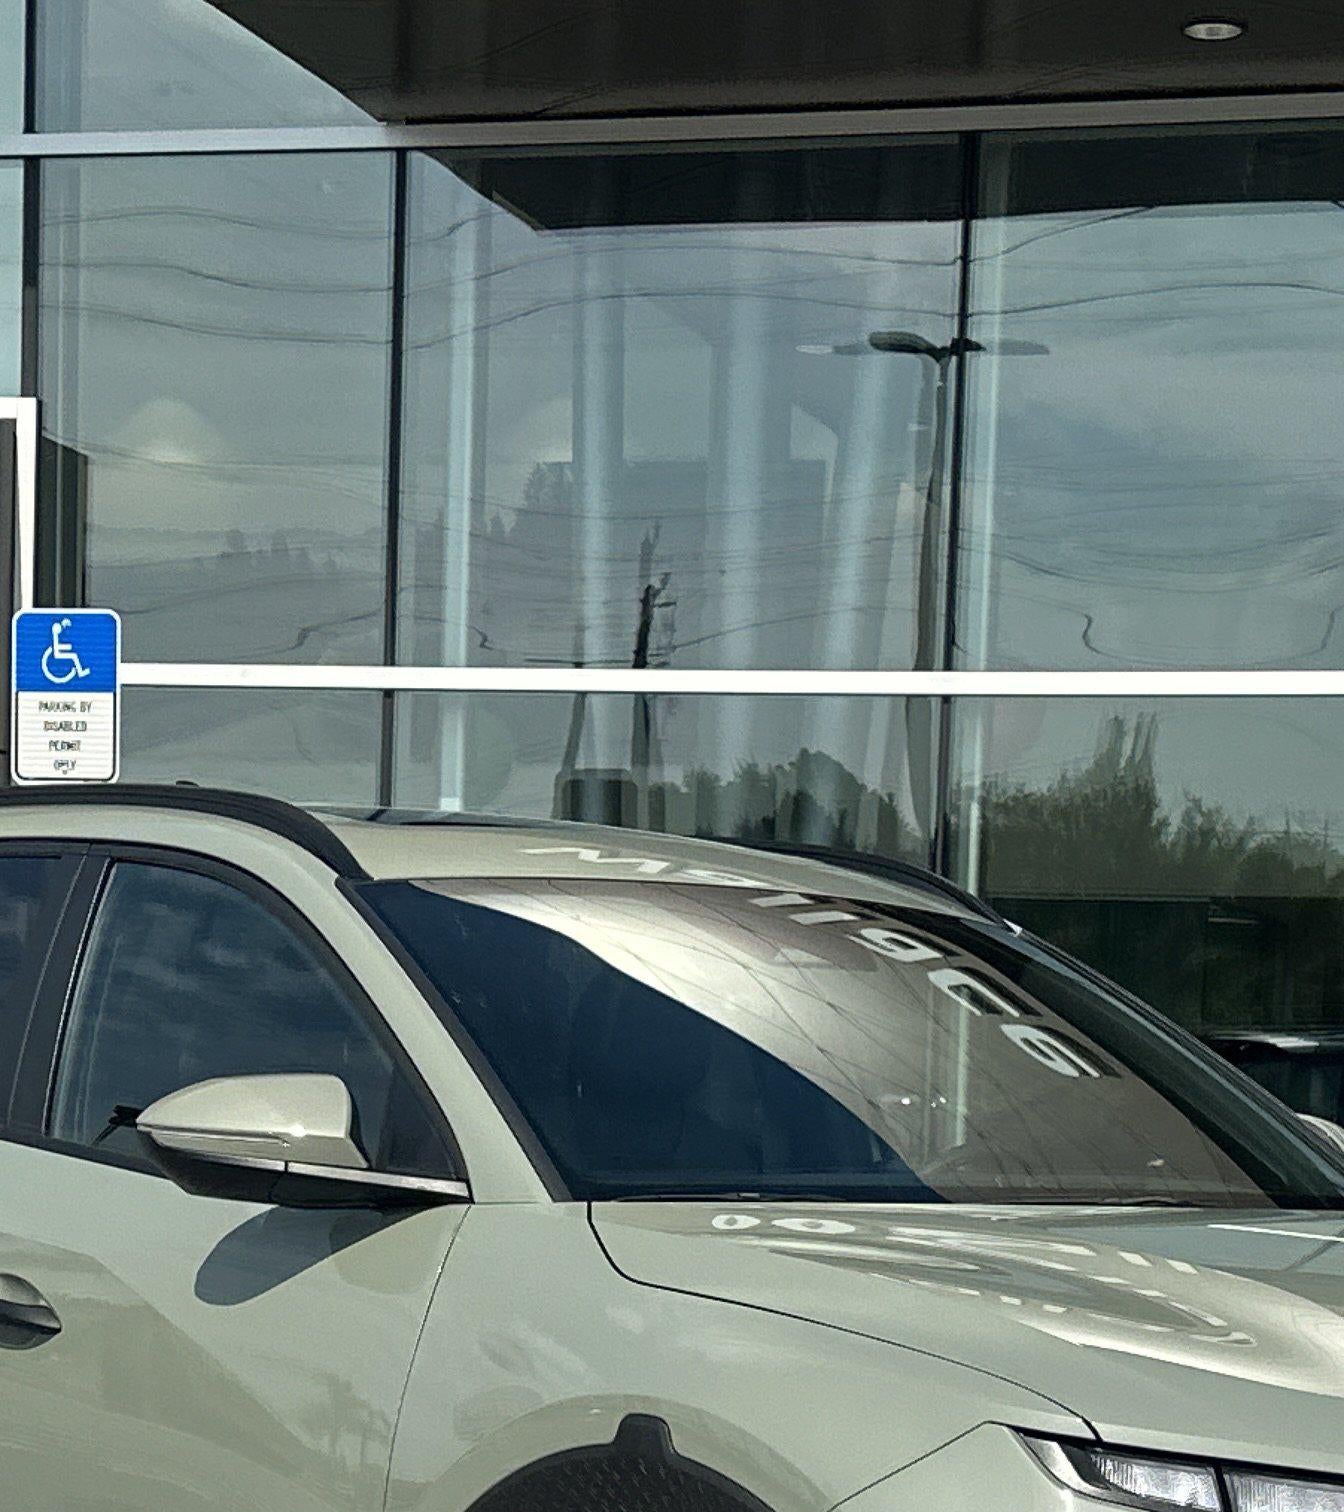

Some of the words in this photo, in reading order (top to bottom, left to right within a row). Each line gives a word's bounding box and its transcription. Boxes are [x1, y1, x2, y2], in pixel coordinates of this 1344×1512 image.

[38, 700, 77, 713] PARKING
[79, 700, 92, 713] BY
[42, 720, 87, 732] DISABLED
